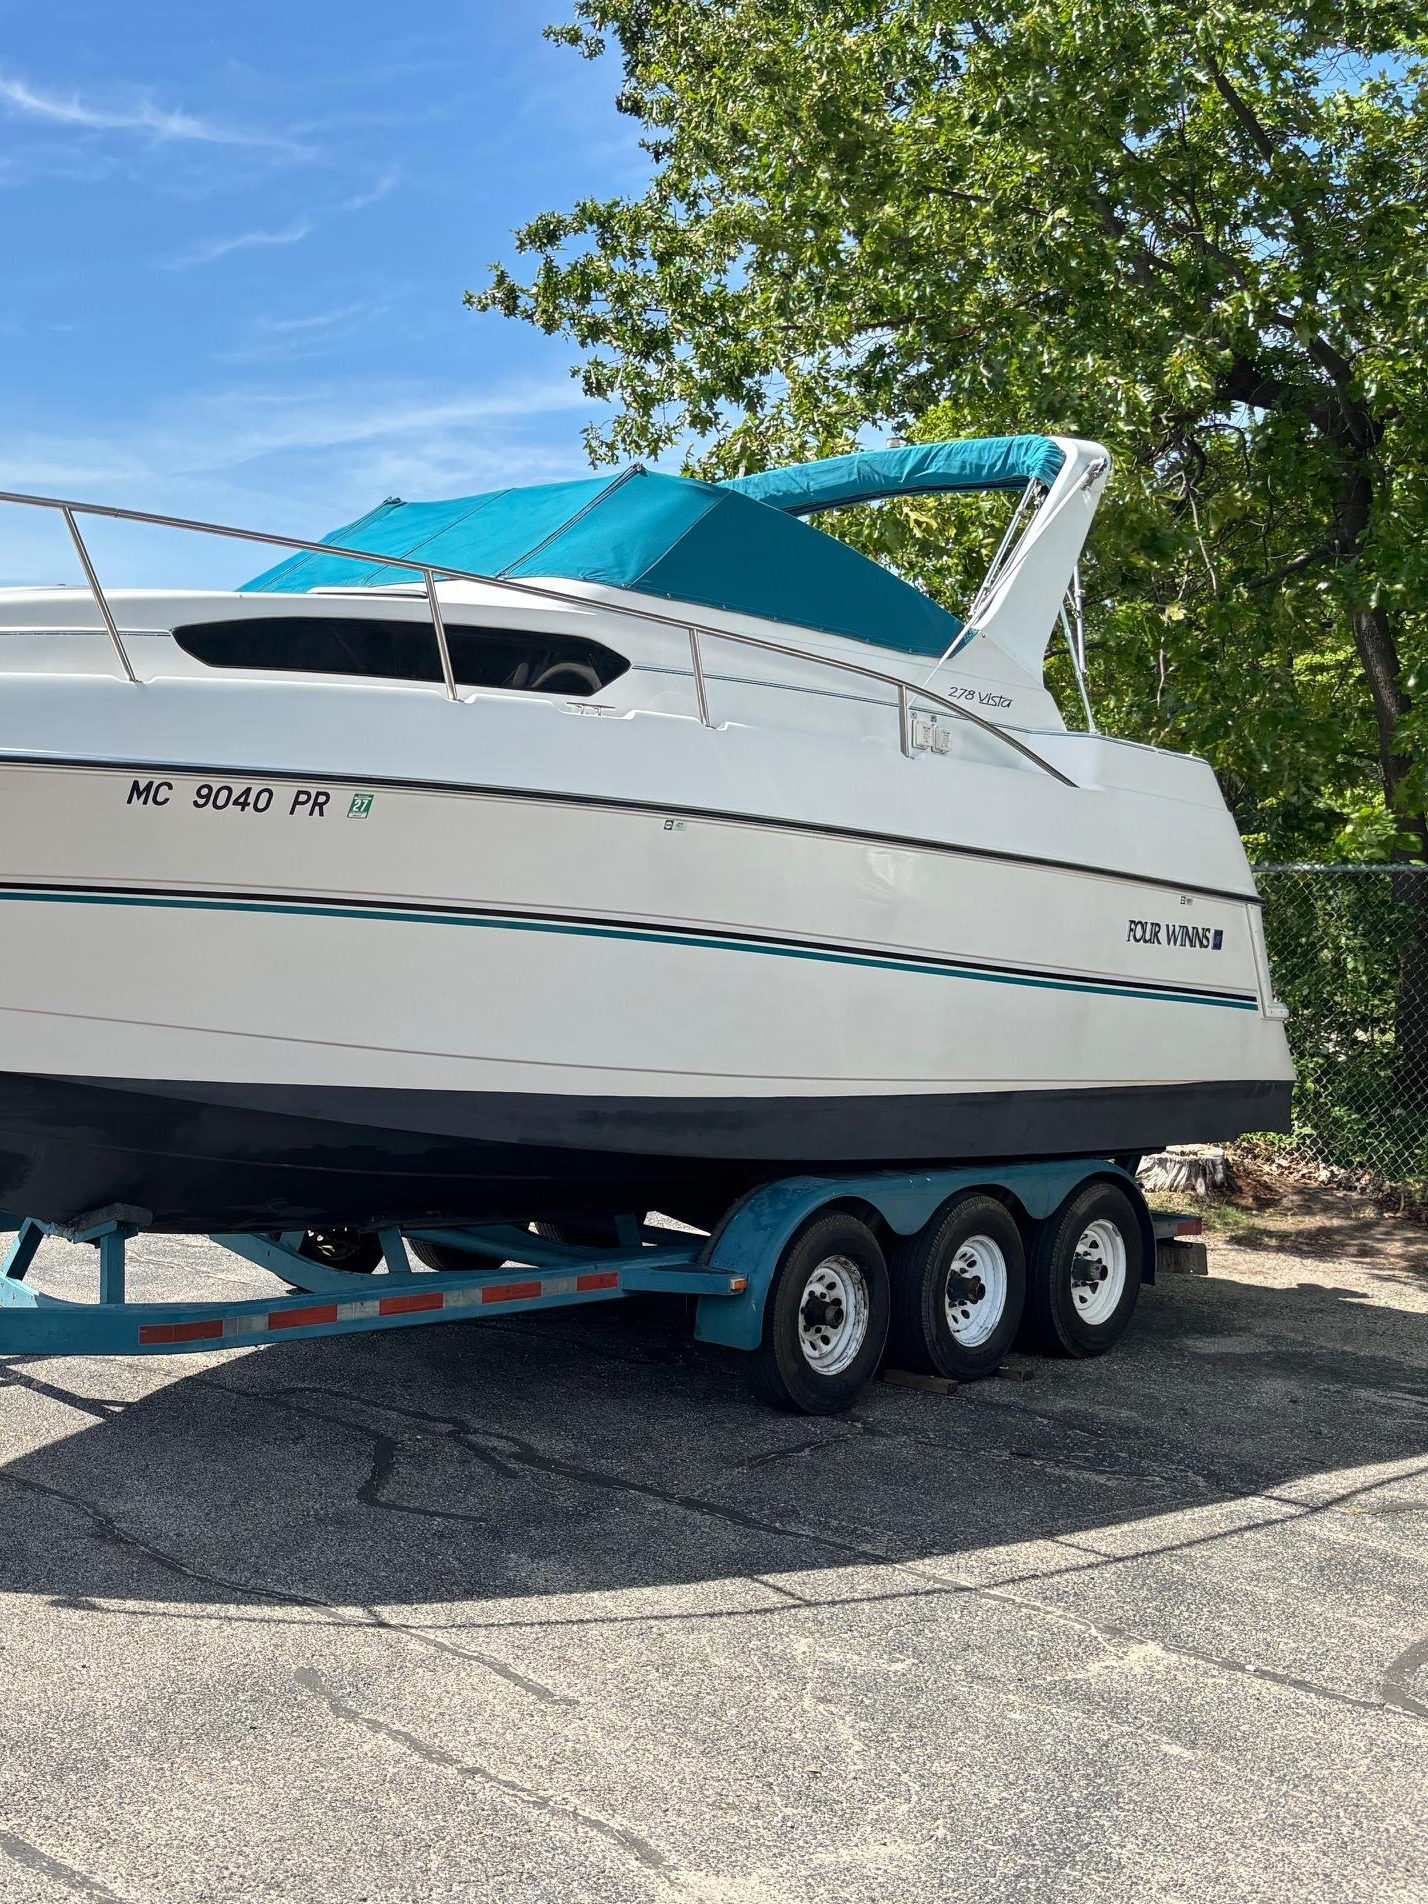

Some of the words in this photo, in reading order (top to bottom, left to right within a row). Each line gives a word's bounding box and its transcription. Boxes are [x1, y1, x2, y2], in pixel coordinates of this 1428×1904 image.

[948, 686, 976, 701] 278
[126, 780, 173, 806] MC
[192, 784, 274, 813] 9040
[289, 790, 331, 817] PR
[352, 799, 369, 812] 27
[1126, 919, 1162, 945] FOUR
[1165, 923, 1211, 949] WINNS
